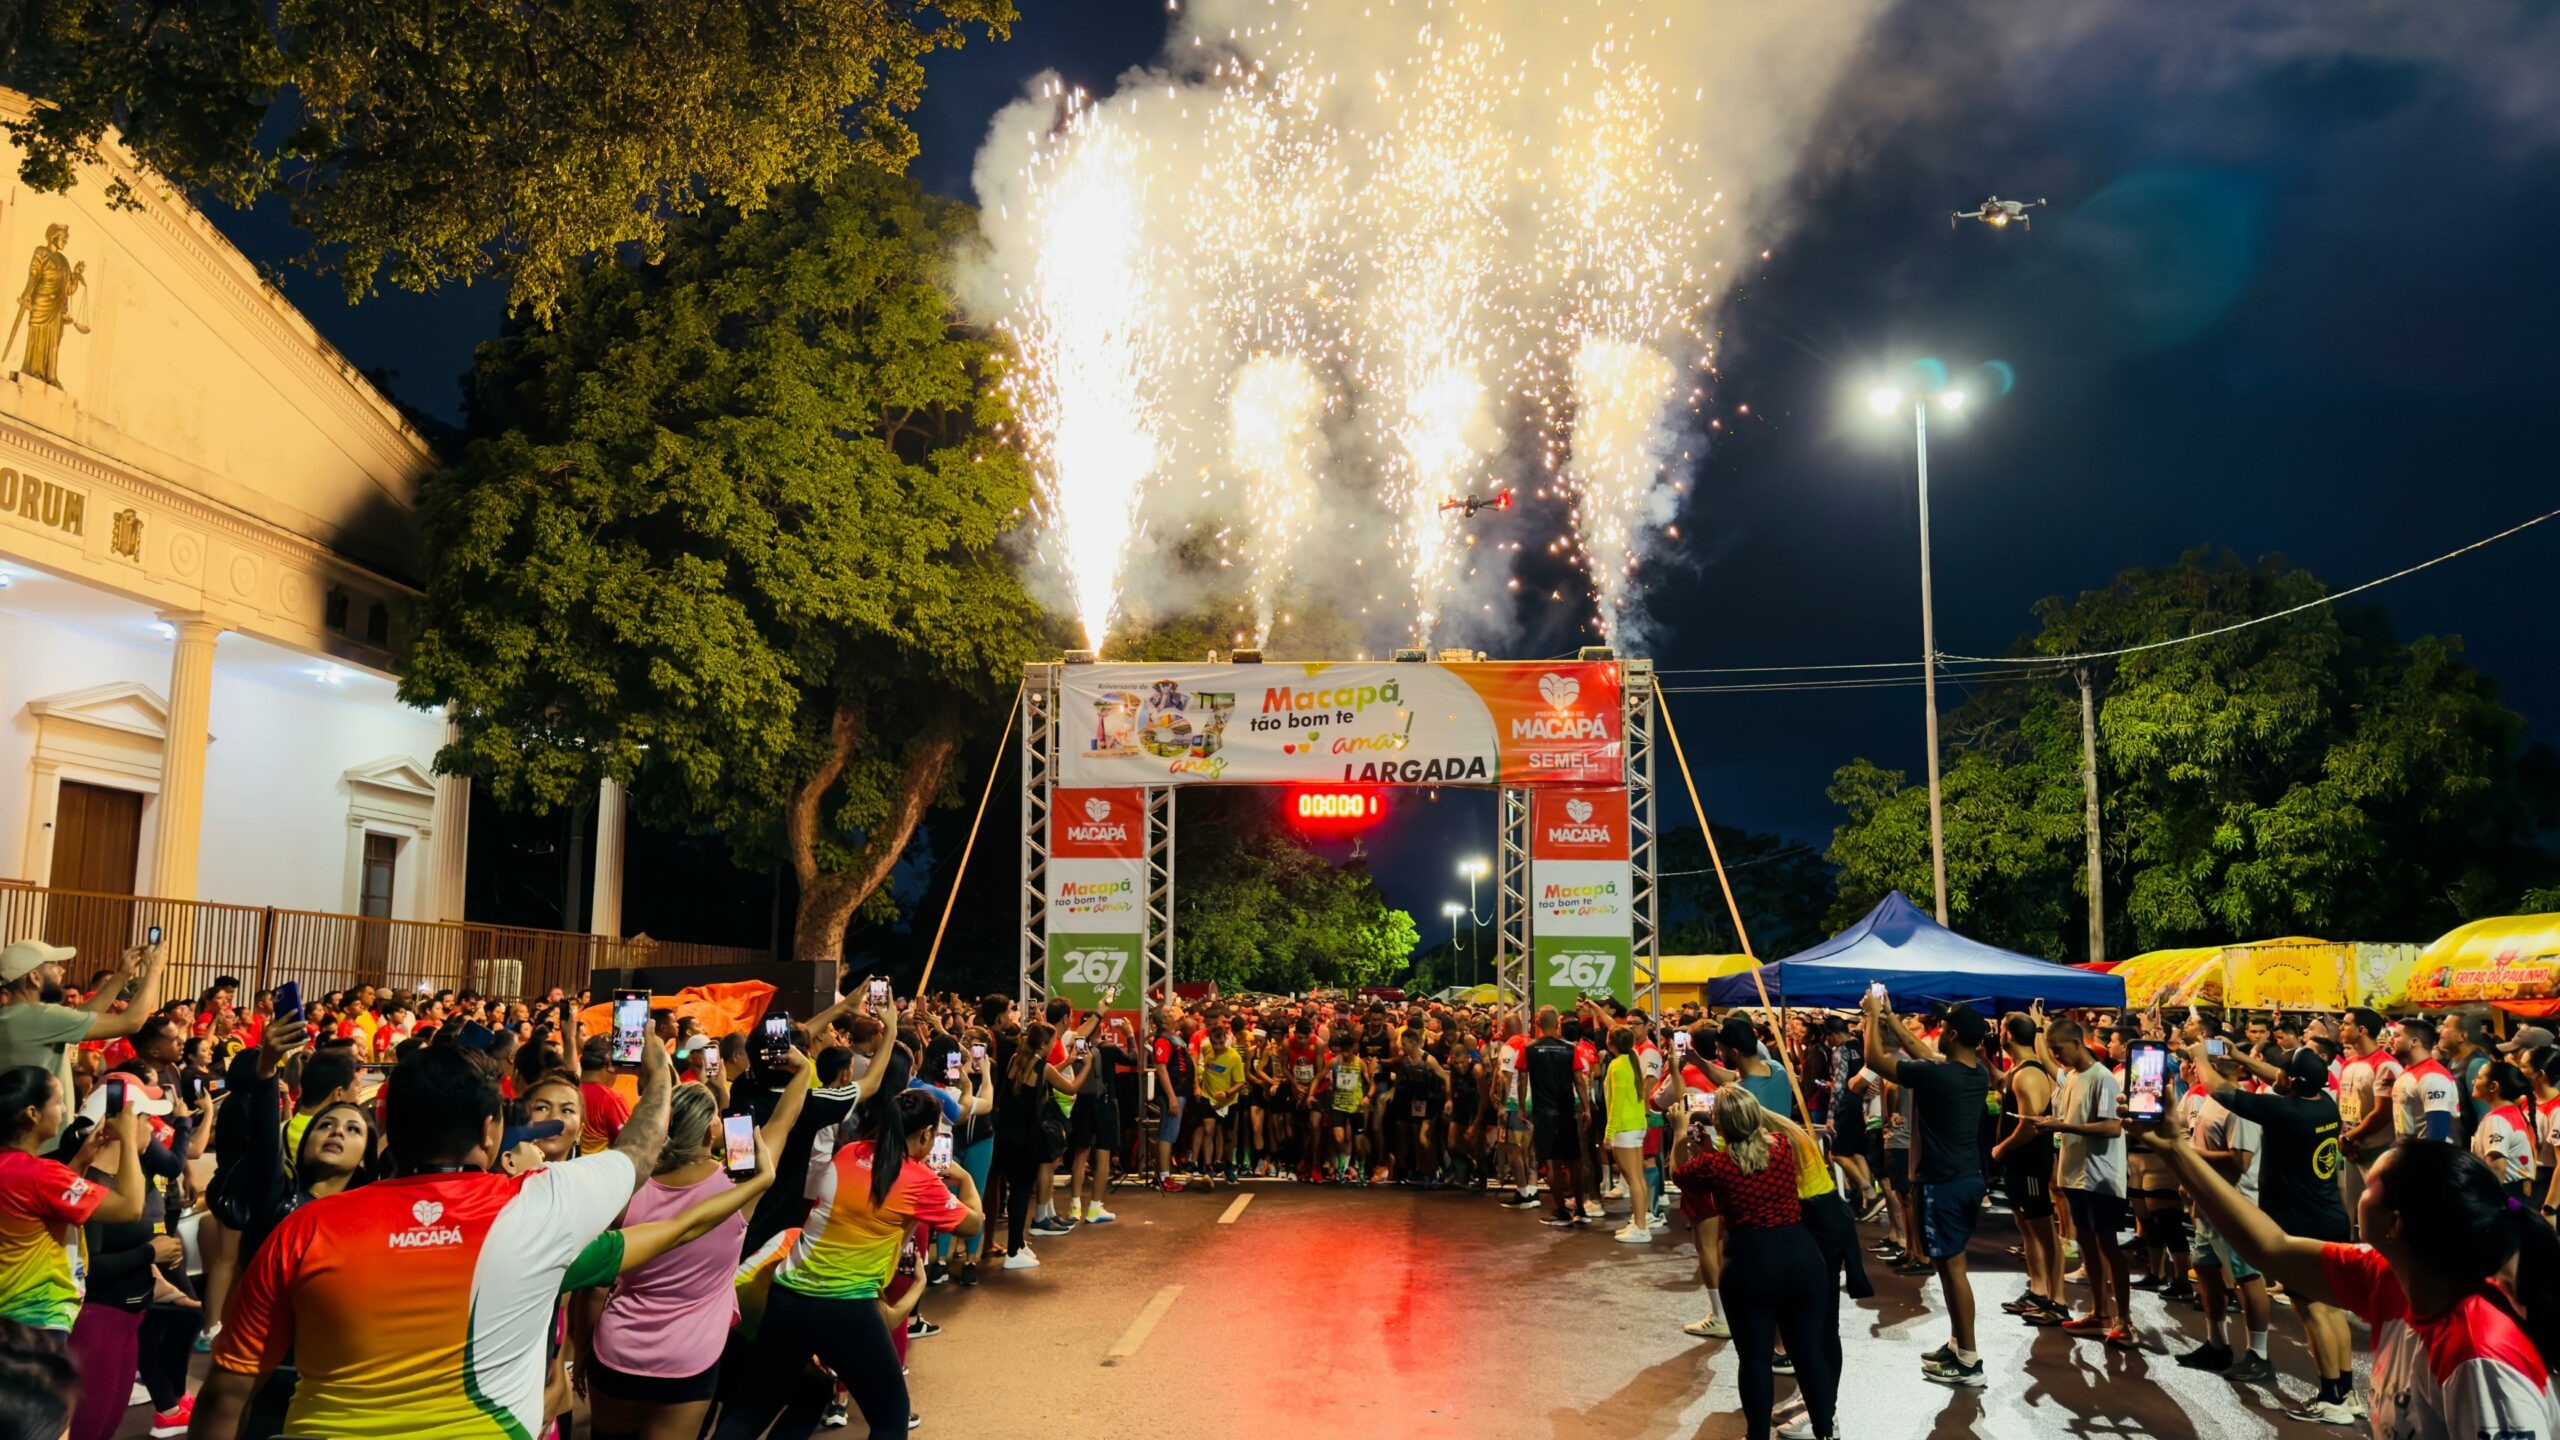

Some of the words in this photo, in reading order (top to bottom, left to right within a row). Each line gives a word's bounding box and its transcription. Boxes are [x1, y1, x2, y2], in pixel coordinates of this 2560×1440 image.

[1262, 678, 1403, 713] Macapá,
[1250, 715, 1282, 732] tão
[1288, 712, 1329, 729] bom
[1336, 710, 1354, 725] te
[1512, 713, 1608, 739] MACAPÁ
[1169, 756, 1229, 781] anos
[1344, 756, 1488, 783] LARGADA
[1068, 823, 1127, 841] MACAPÁ
[1549, 825, 1611, 843] MACAPÁ
[1061, 879, 1133, 897] Macapá,
[1544, 881, 1618, 899] Macapá,
[1074, 895, 1095, 905] bom
[1558, 898, 1580, 907] bom
[1063, 951, 1129, 984] 267
[1549, 954, 1616, 987] 267
[2455, 970, 2486, 983] FRITAS
[1093, 983, 1126, 997] ans
[2427, 1090, 2446, 1100] 267
[389, 1225, 463, 1248] MACAPÁ
